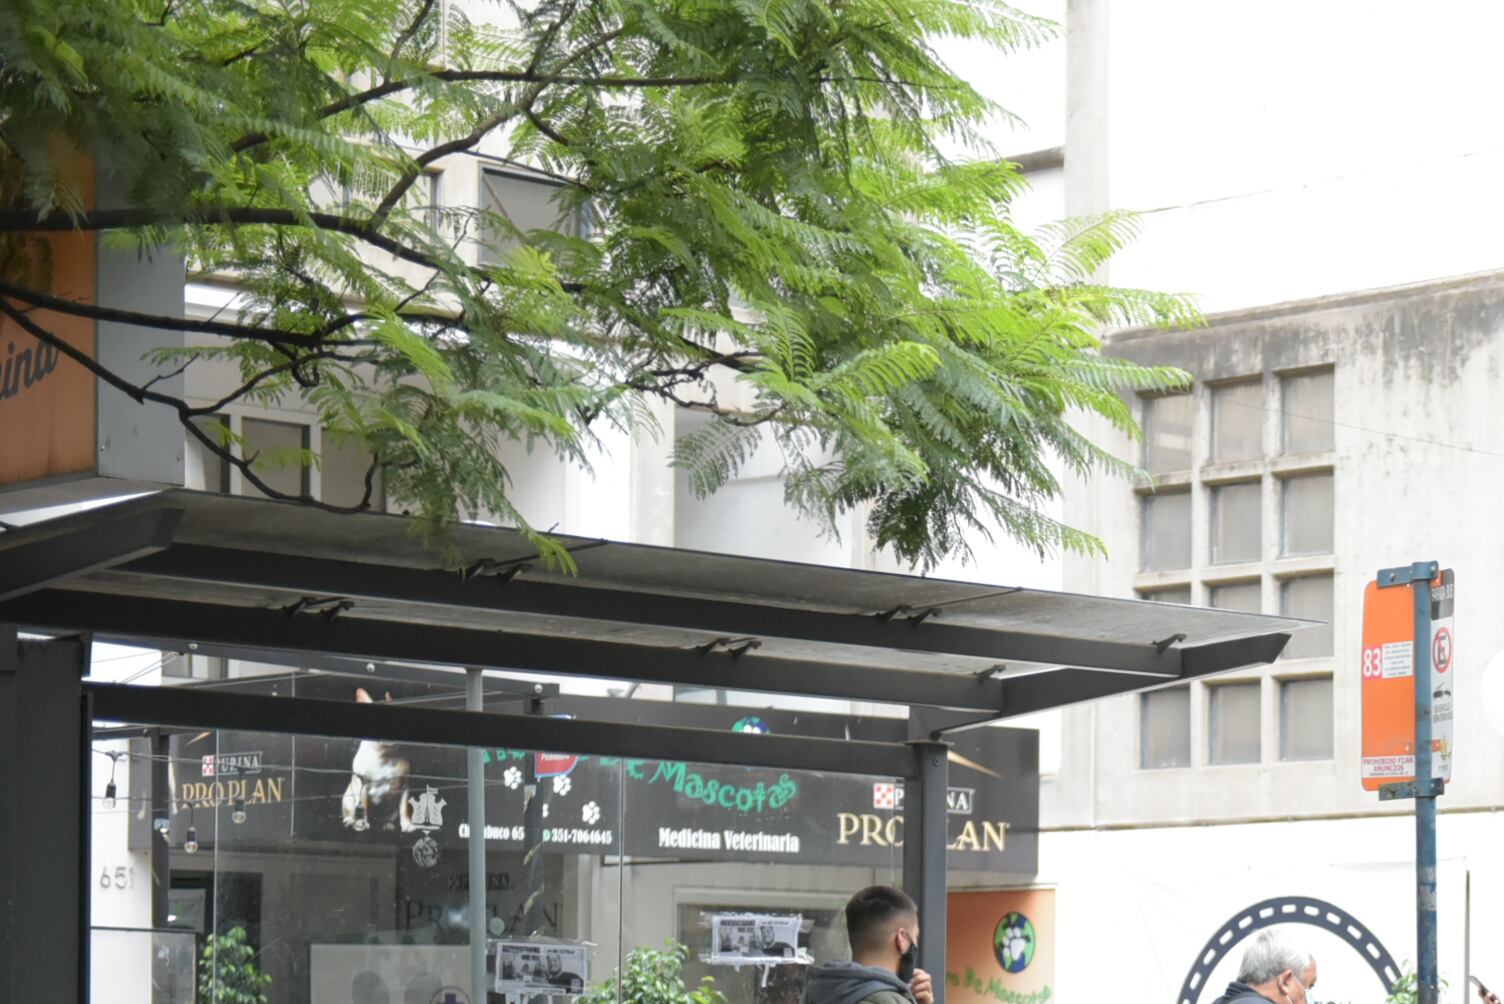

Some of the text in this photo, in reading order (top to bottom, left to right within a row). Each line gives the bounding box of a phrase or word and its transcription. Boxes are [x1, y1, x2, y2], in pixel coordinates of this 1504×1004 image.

[1363, 648, 1382, 677] 83
[181, 782, 224, 810] PRO
[658, 827, 800, 853] Medicina Veterinaria
